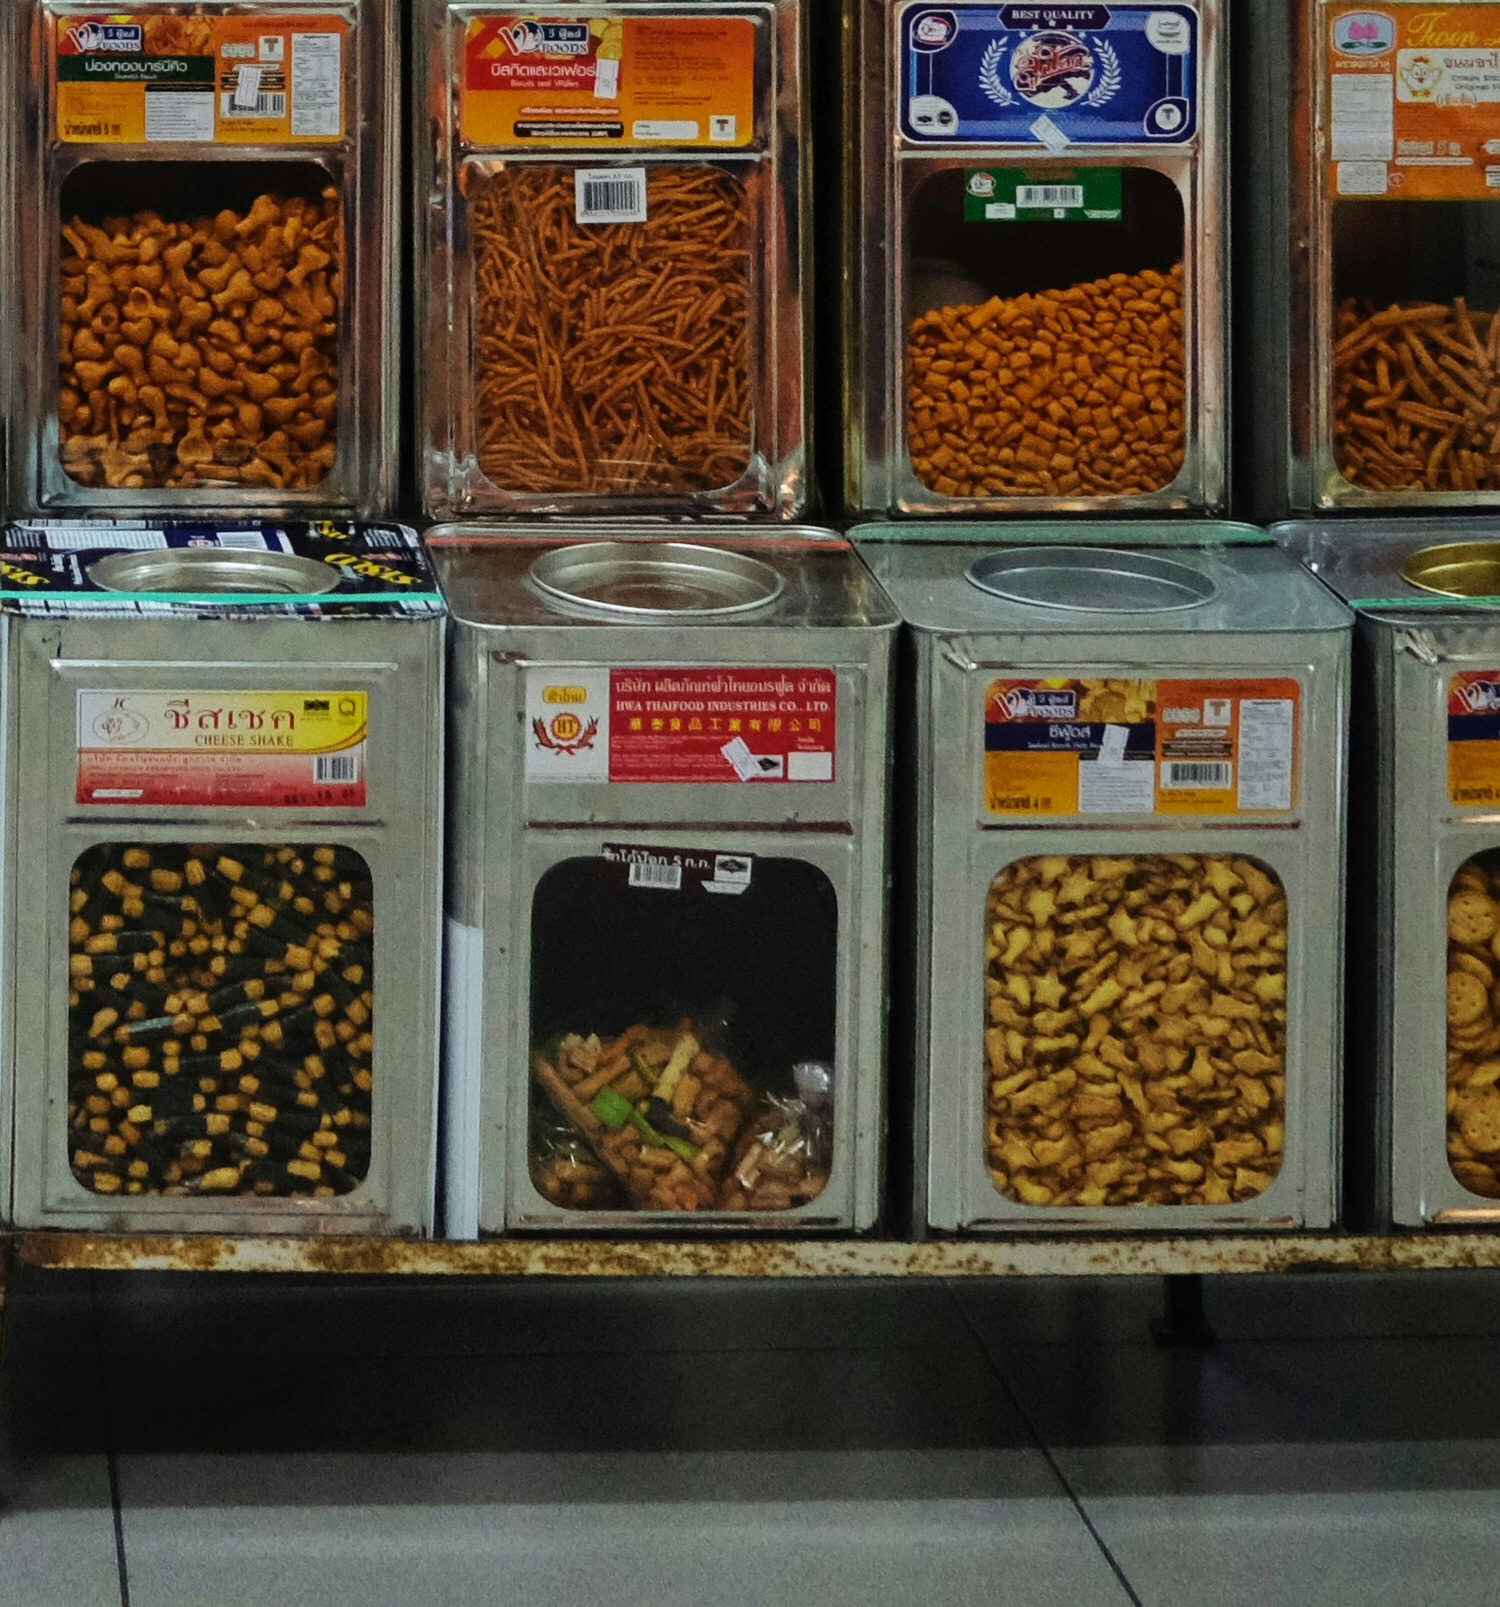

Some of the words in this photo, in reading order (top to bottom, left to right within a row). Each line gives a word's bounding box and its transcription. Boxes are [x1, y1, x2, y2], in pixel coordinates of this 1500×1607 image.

[1011, 9, 1041, 20] BEST
[1043, 9, 1095, 22] QUALITY
[1406, 11, 1477, 48] Twin
[615, 675, 651, 693] บริษัท
[797, 676, 832, 694] จำกัด
[615, 701, 643, 712] HWA
[646, 701, 705, 712] THAIFOOD
[706, 701, 777, 712] INDUSTRIES
[194, 734, 246, 747] CHEESE
[249, 734, 295, 747] SHAKE
